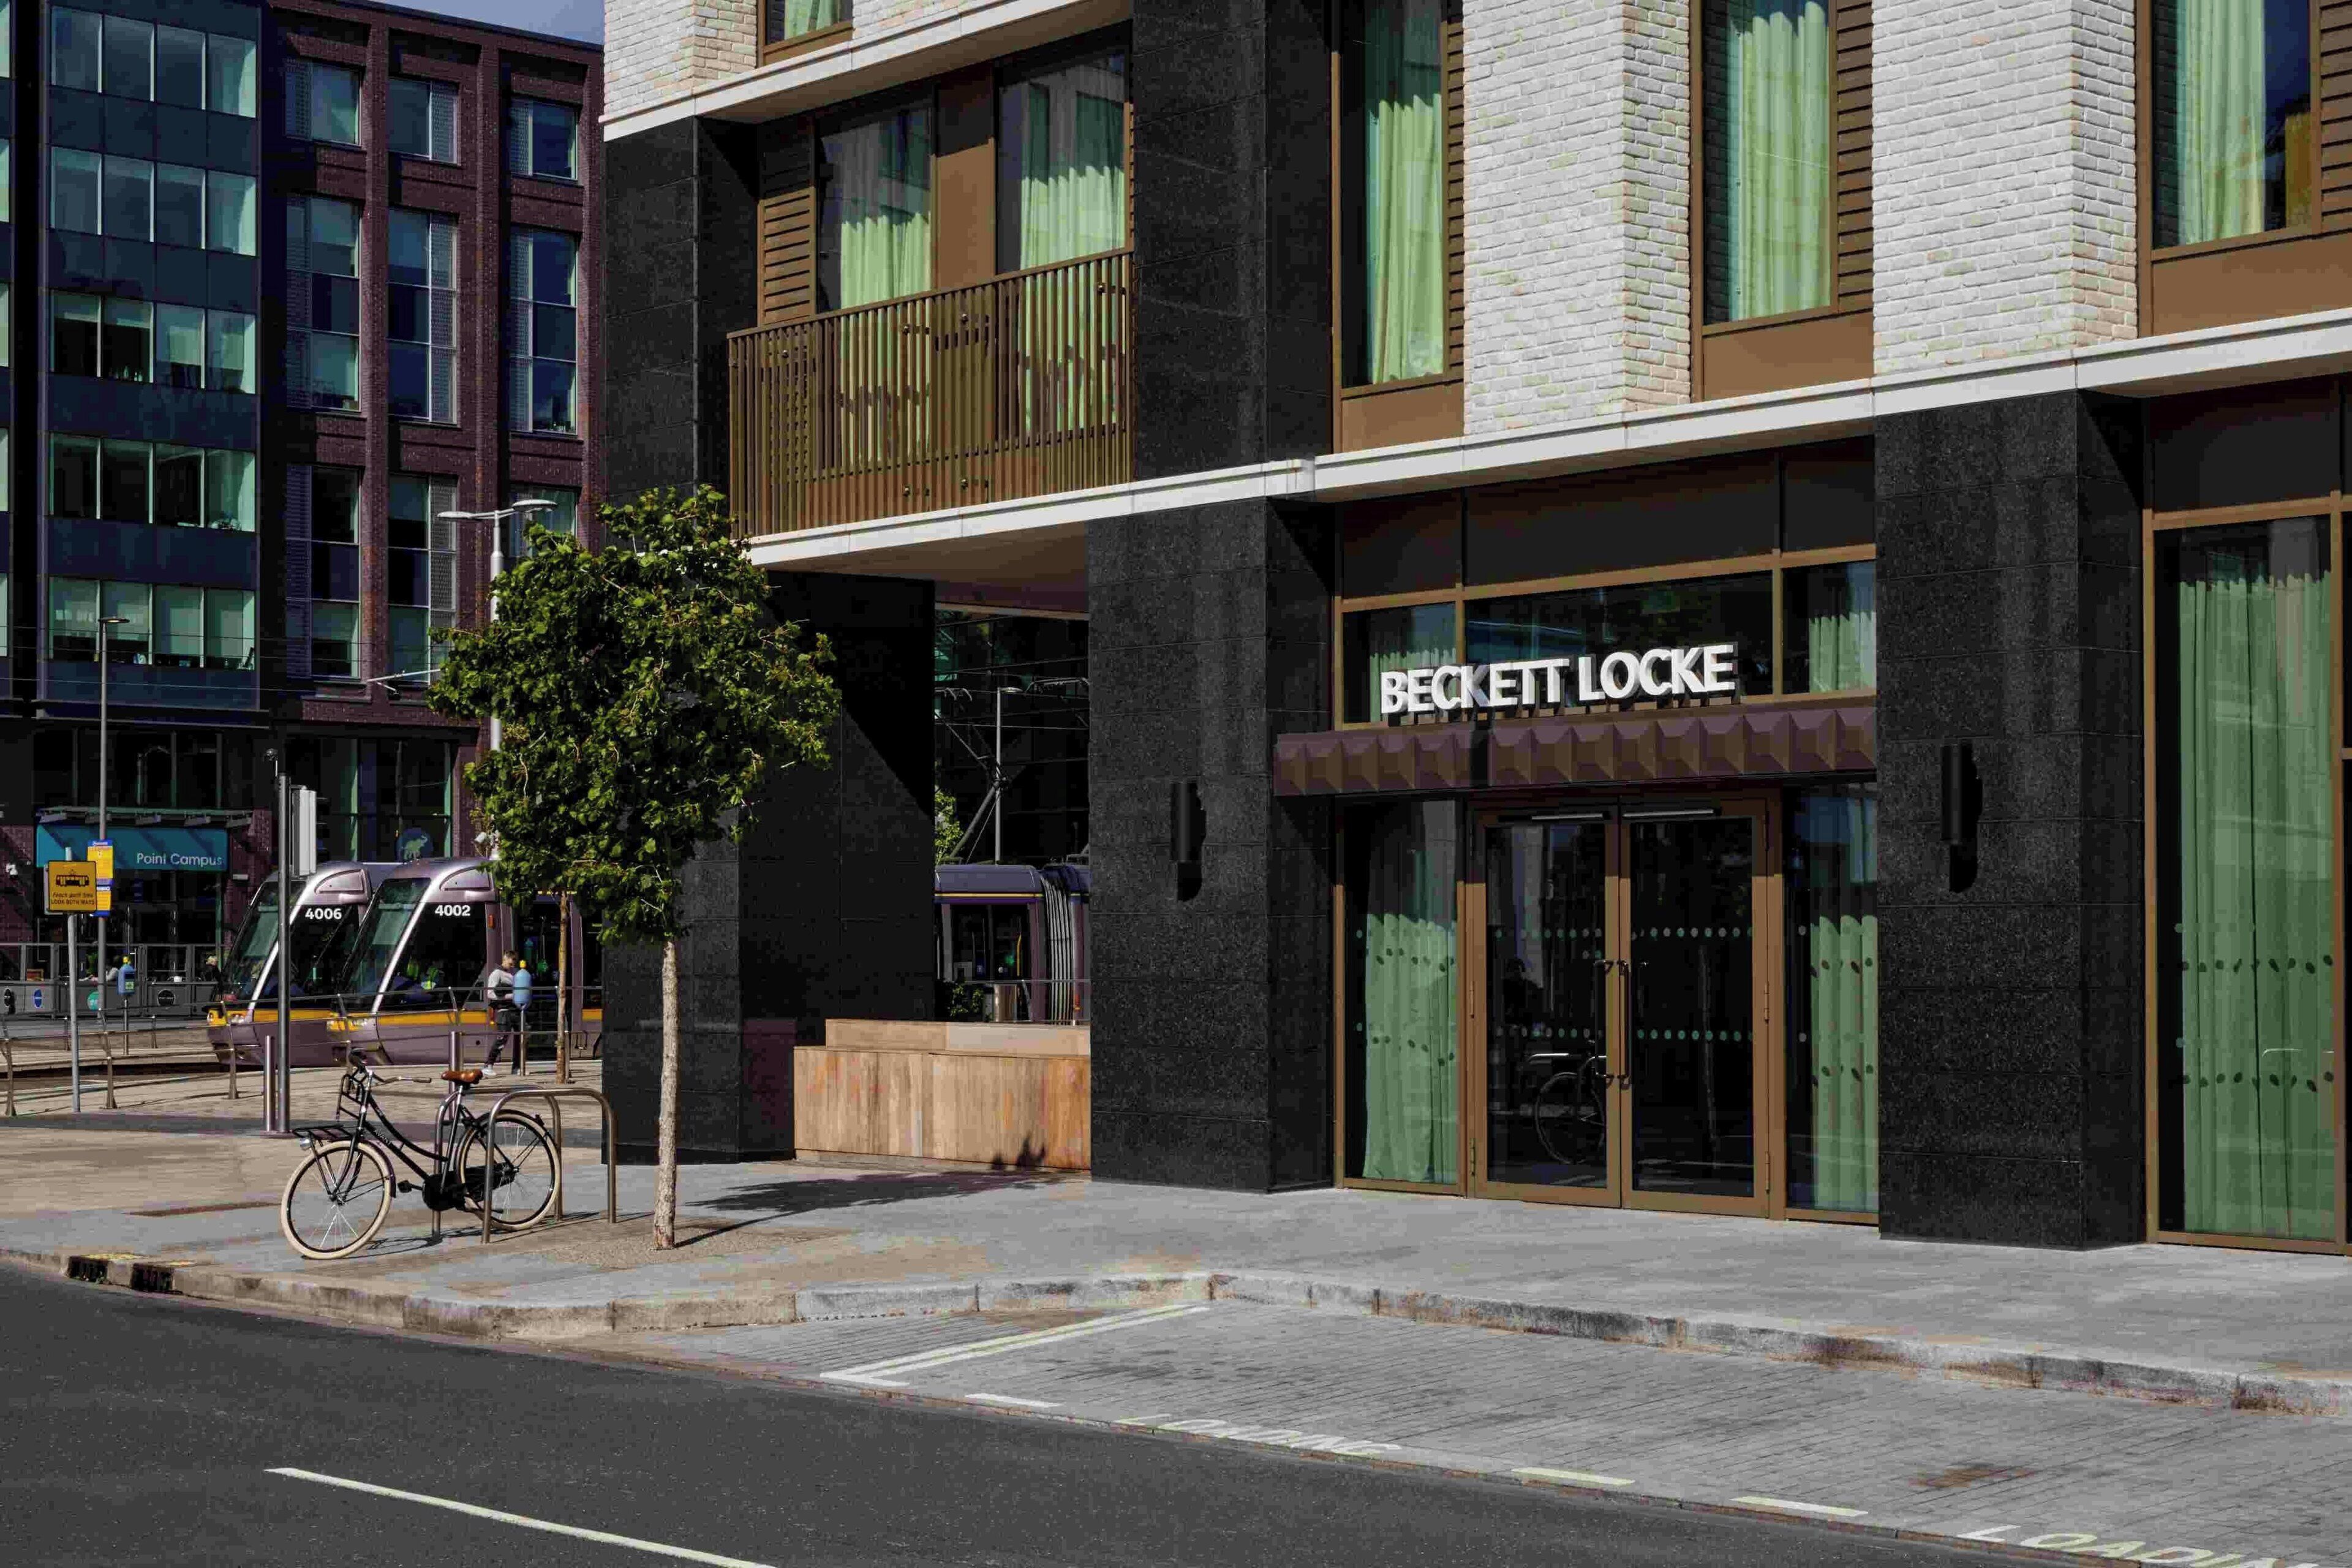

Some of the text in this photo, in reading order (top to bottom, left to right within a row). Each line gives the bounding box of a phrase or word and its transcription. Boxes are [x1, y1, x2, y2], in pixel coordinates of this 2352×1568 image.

[1381, 644, 1736, 714] BECKETT LOCKE
[170, 853, 222, 867] Campus
[304, 908, 342, 920] 4006
[434, 904, 471, 917] 4002
